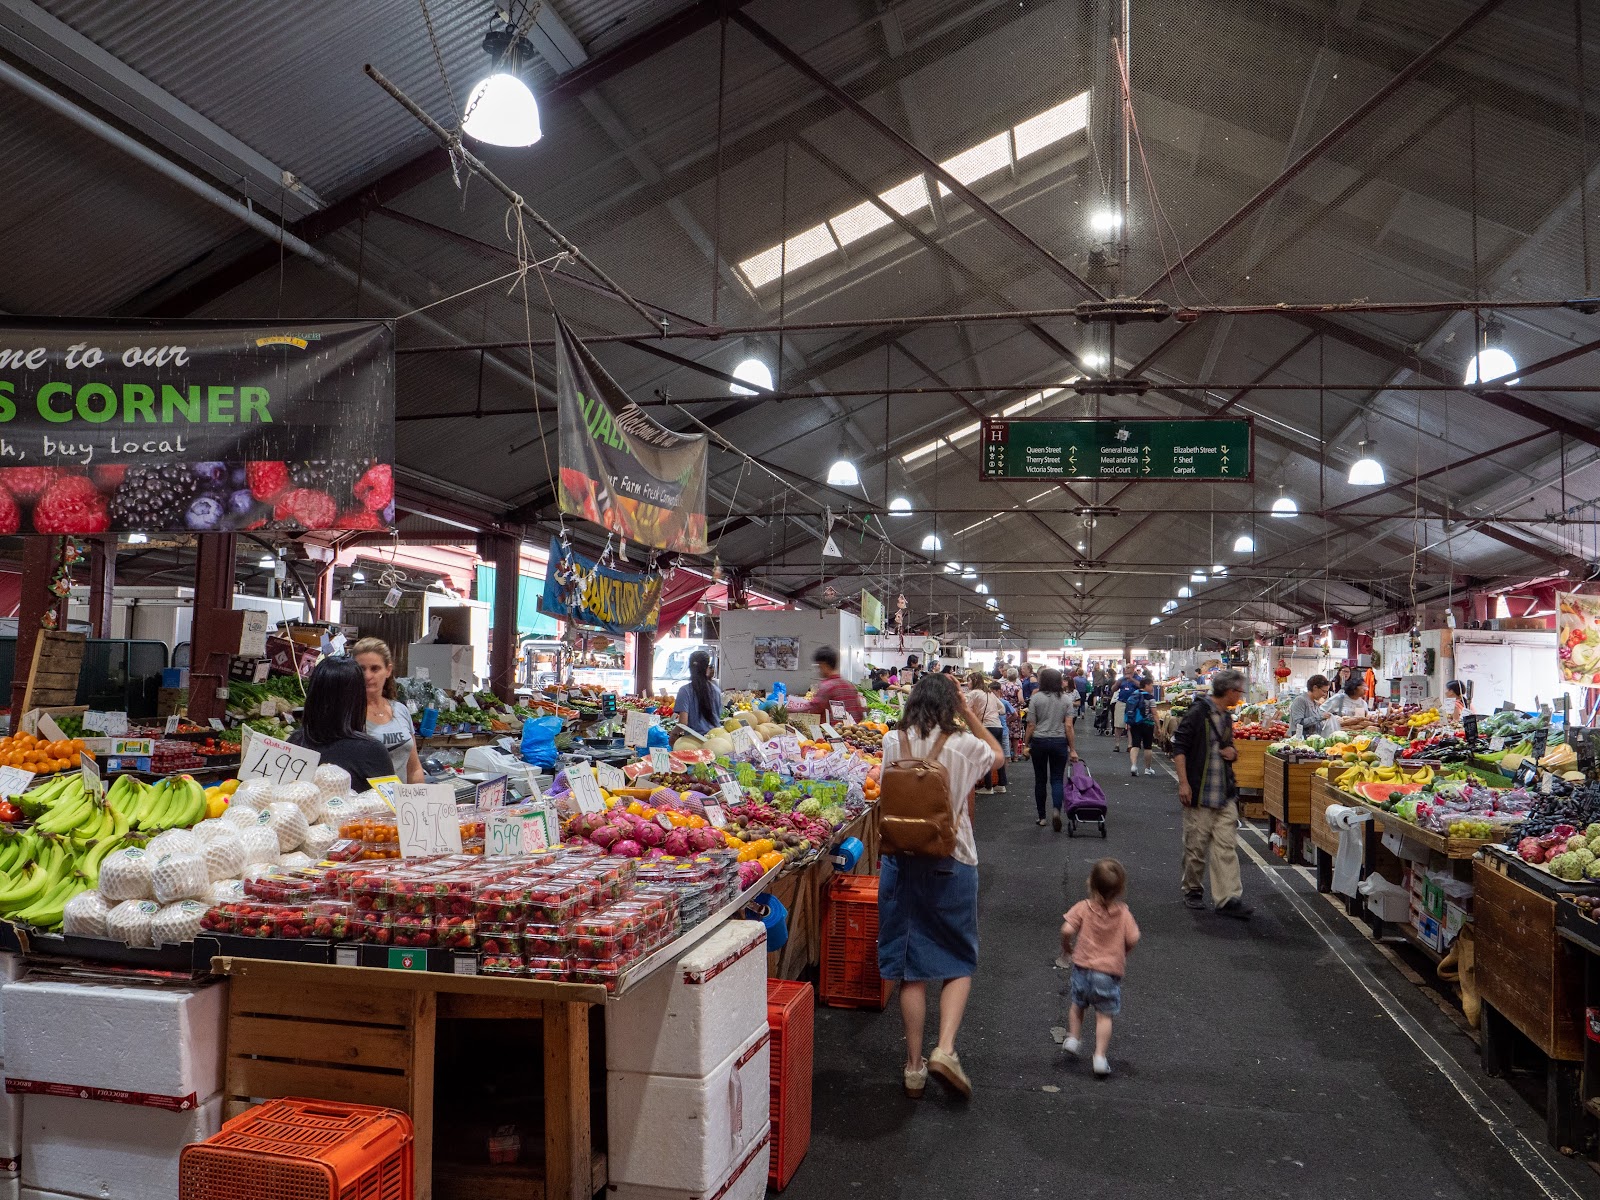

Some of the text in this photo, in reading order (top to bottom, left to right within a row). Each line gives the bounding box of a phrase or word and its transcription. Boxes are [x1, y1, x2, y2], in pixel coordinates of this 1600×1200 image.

[64, 341, 104, 370] to
[122, 344, 189, 368] our
[36, 382, 273, 423] CORNER
[991, 430, 1003, 441] H
[43, 435, 94, 465] buy
[111, 435, 187, 454] local
[1026, 446, 1062, 454] Queen Street
[1100, 446, 1138, 454] General Retail
[1173, 446, 1217, 454] Elizabeth Street
[1100, 466, 1131, 474] Food Court
[1173, 466, 1196, 475] Carpark
[620, 475, 642, 495] Farm
[643, 483, 660, 500] Fresh
[383, 732, 404, 745] NIKE
[97, 1089, 129, 1098] BROCCOLI
